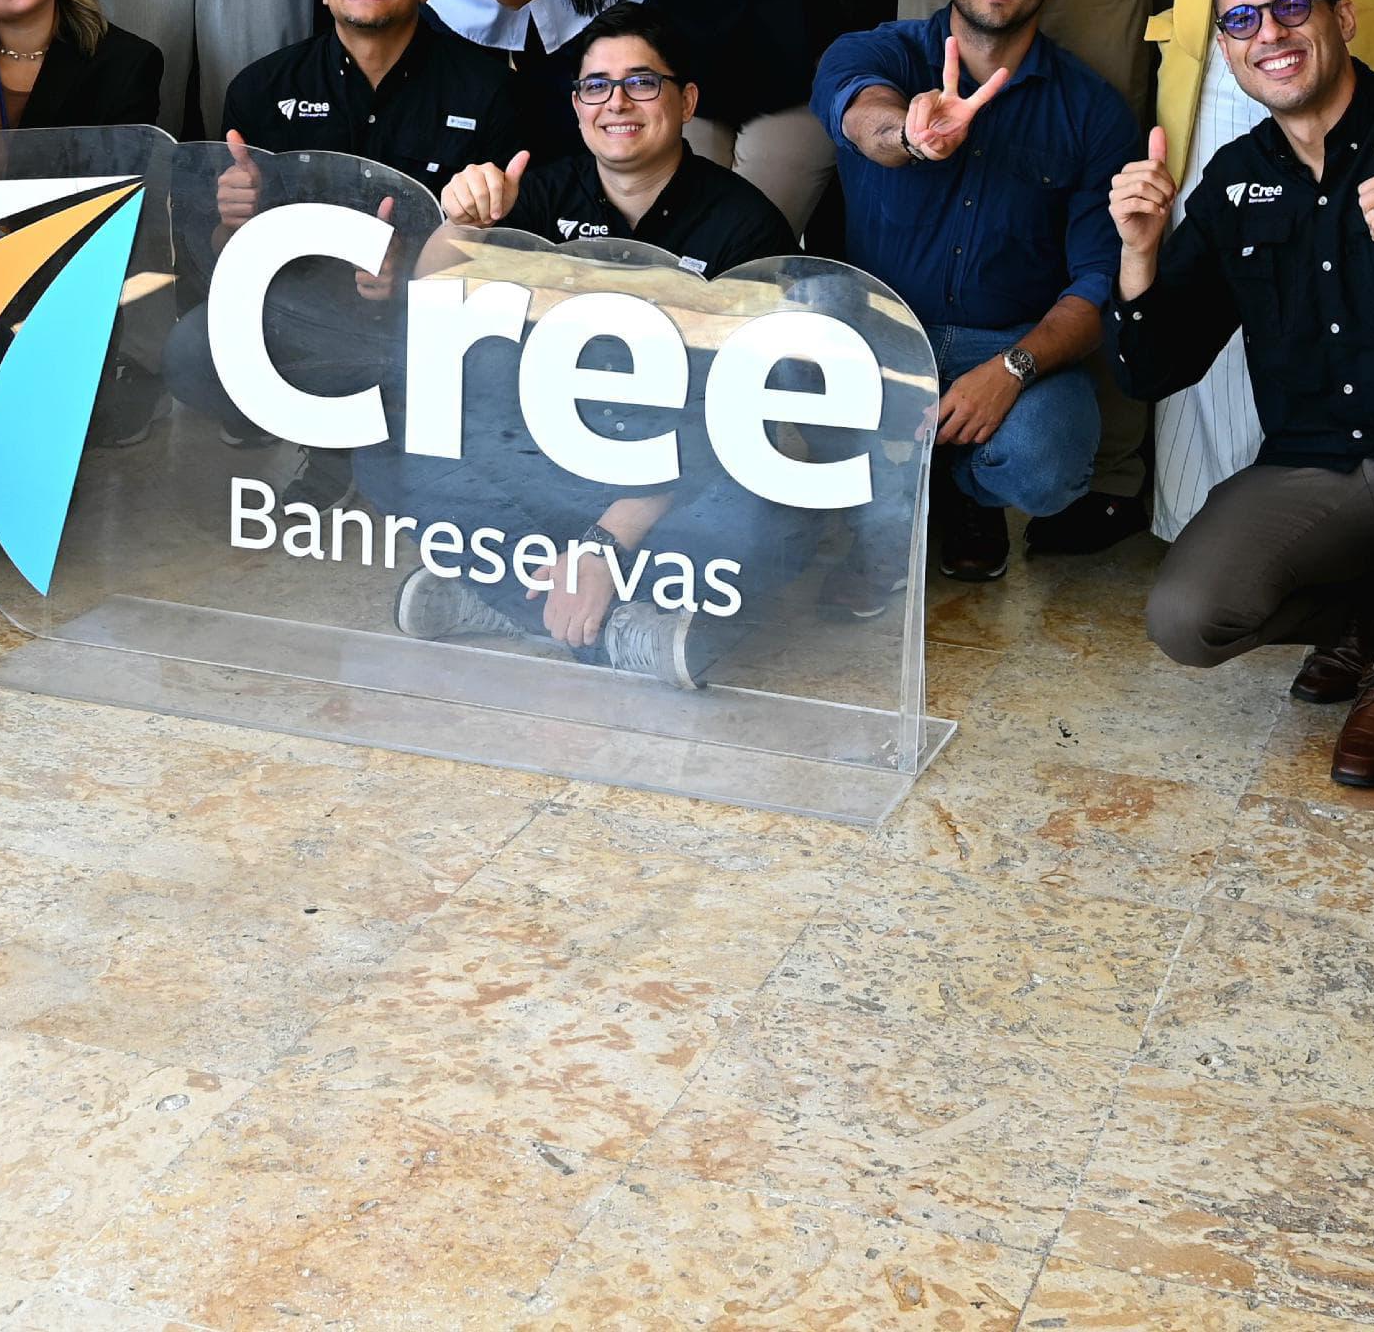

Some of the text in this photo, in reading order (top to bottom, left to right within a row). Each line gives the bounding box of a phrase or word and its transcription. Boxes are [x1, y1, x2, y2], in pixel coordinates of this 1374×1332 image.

[298, 100, 330, 112] Cree
[1248, 183, 1283, 198] Cree
[208, 201, 885, 511] Cree
[230, 476, 745, 618] Banreservas
